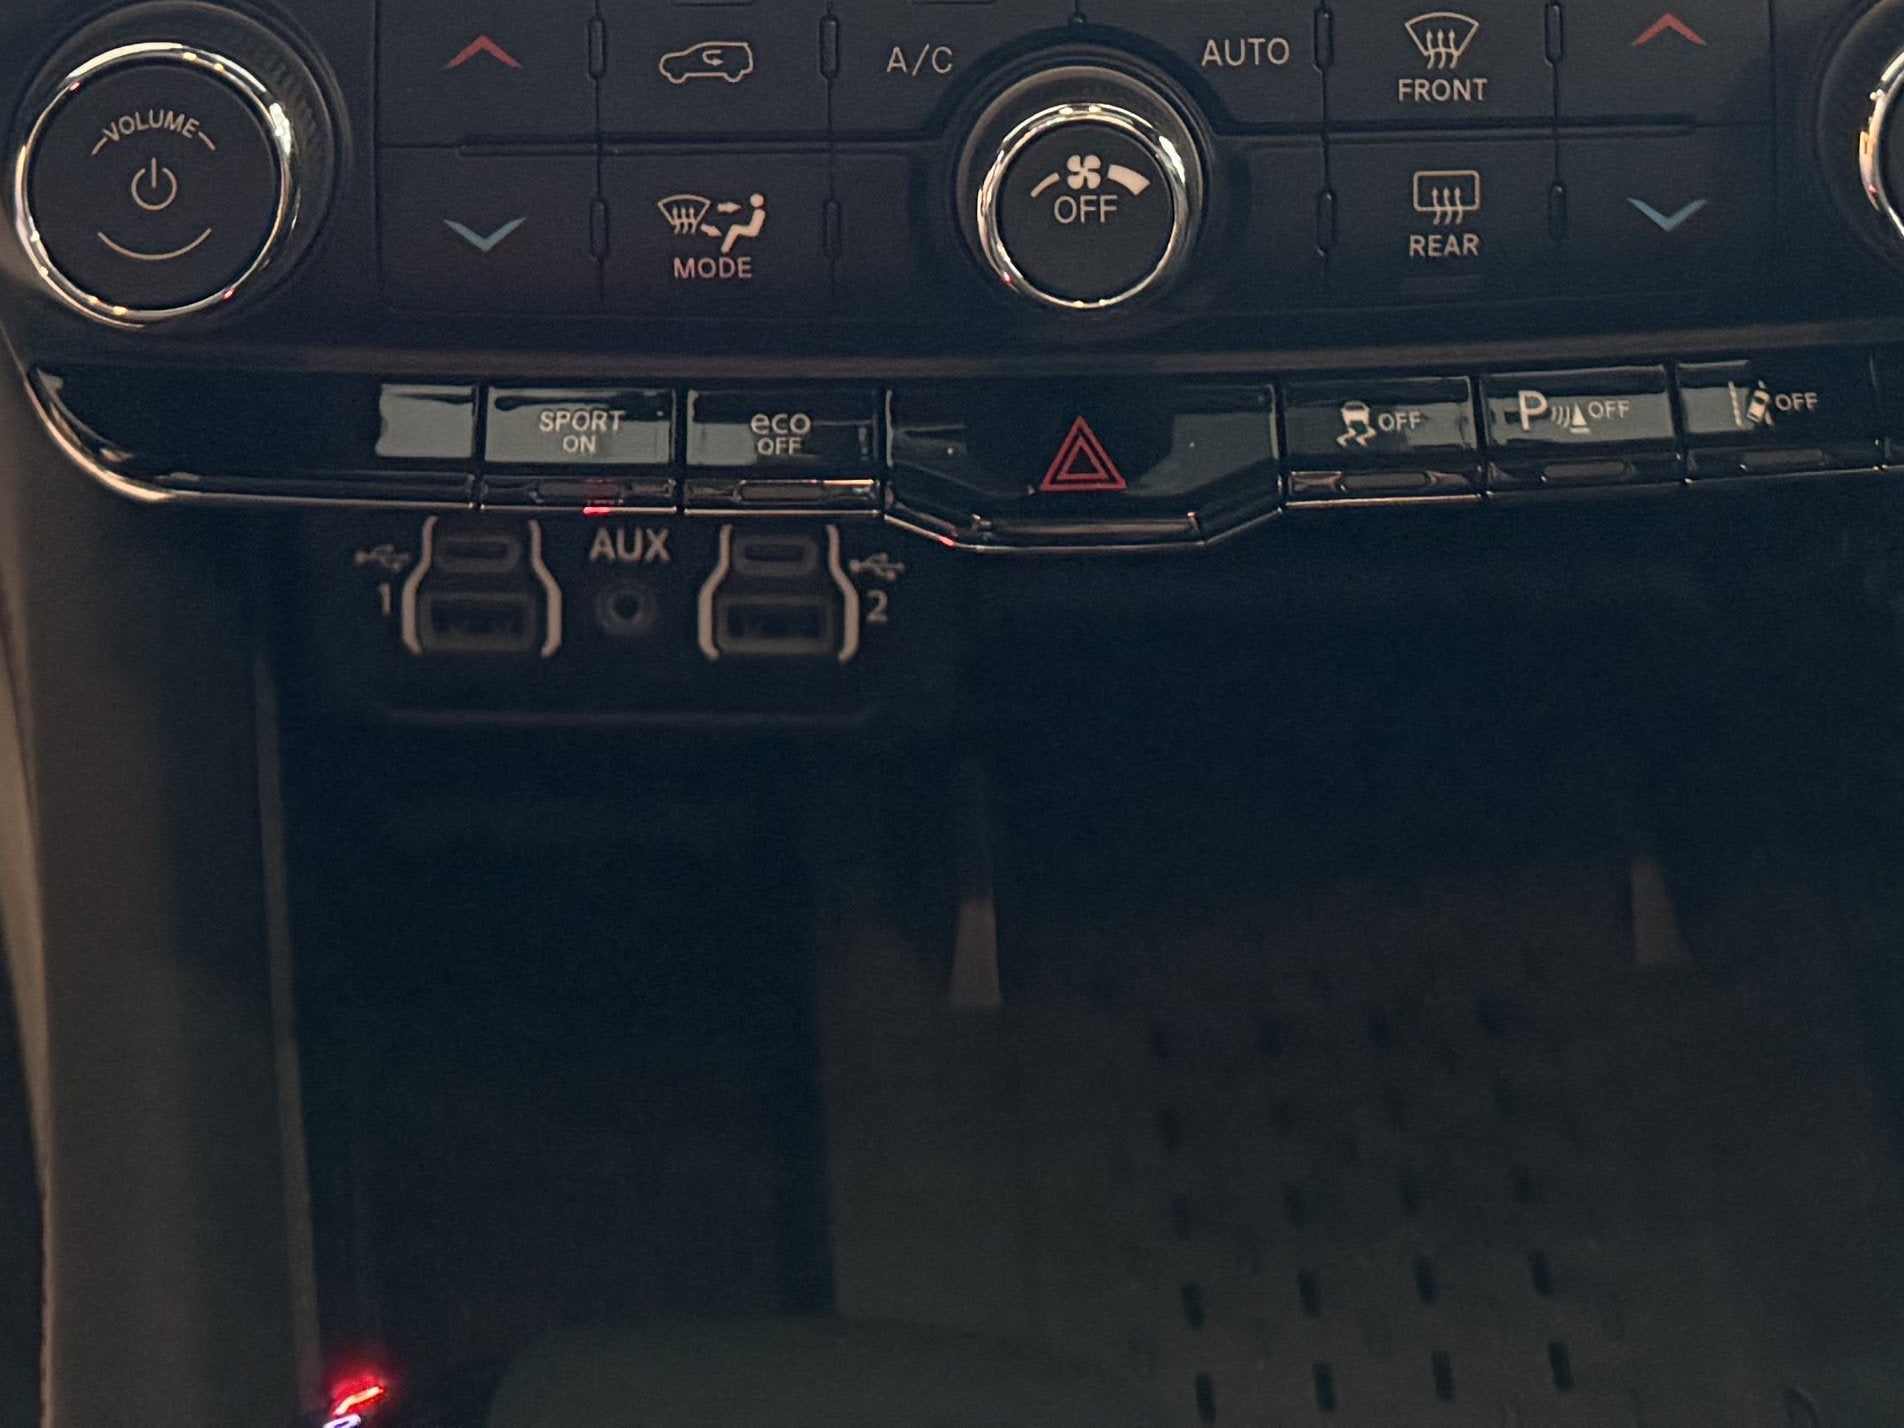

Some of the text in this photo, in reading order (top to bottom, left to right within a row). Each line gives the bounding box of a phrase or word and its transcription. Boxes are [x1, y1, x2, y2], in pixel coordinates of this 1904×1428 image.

[886, 46, 952, 75] A/C
[1202, 39, 1289, 67] AUTO
[1398, 79, 1487, 102] FRONT
[103, 109, 201, 142] VOLUME
[1053, 195, 1117, 224] OFF
[1408, 234, 1479, 258] REAR
[673, 257, 752, 279] MODE
[1588, 400, 1630, 420] OFF
[1776, 392, 1819, 411] OFF
[539, 410, 624, 432] SPORT
[750, 411, 810, 436] eco
[1378, 410, 1420, 432] OFF
[563, 435, 596, 454] ON
[757, 438, 801, 455] OFF
[590, 530, 669, 562] AUX
[377, 583, 393, 616] 1
[867, 590, 888, 624] 2
